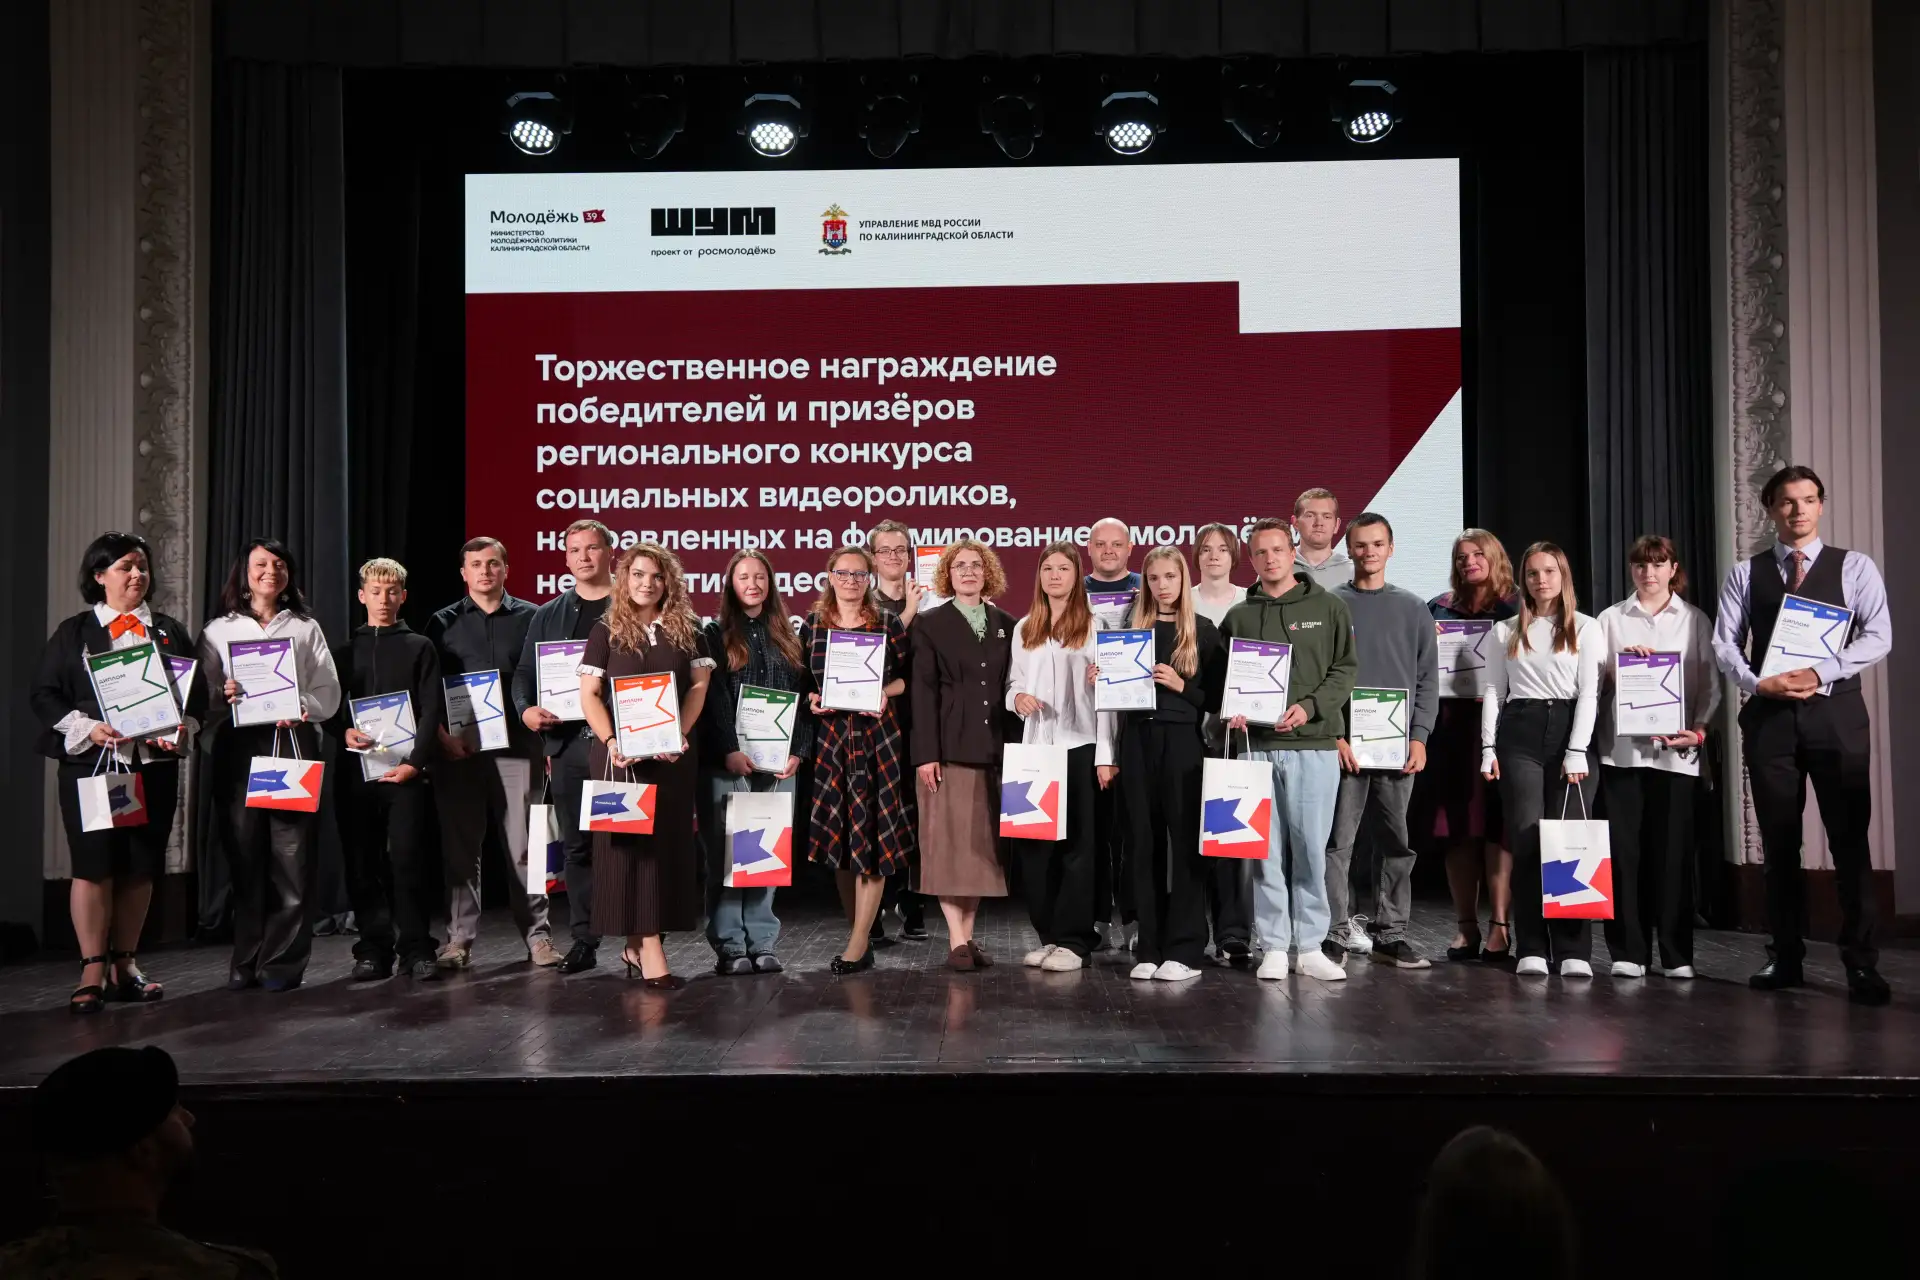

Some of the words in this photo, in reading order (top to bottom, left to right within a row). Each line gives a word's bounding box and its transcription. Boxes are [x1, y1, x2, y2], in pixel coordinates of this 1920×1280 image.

[490, 209, 579, 225] Молодёжь
[586, 212, 598, 221] 39
[650, 207, 776, 236] ШУМ
[859, 219, 919, 228] УПРАВЛЕНИЕ
[921, 219, 942, 229] МВД
[944, 218, 981, 227] РОССИИ
[490, 229, 545, 237] МИНИСТЕРСТВО
[490, 236, 540, 245] МОЛОДЁЖНОЙ
[859, 232, 873, 241] ПО
[875, 230, 969, 241] КАЛИНИНГРАДСКОЙ
[971, 231, 1014, 240] ОБЛАСТИ
[490, 244, 558, 252] КАЛИНИНГРАДСКОЙ
[650, 249, 681, 257] проект
[698, 245, 776, 258] росмолодёжь
[535, 354, 810, 388] Торжественное
[820, 354, 1058, 386] награждение
[536, 394, 766, 428] победителей
[777, 401, 797, 421] и
[808, 392, 976, 429] призёров
[536, 443, 801, 473] регионального
[810, 440, 973, 470] конкурса
[536, 486, 749, 514] социальных
[759, 484, 1017, 514] видеороликов,
[795, 528, 832, 549] на
